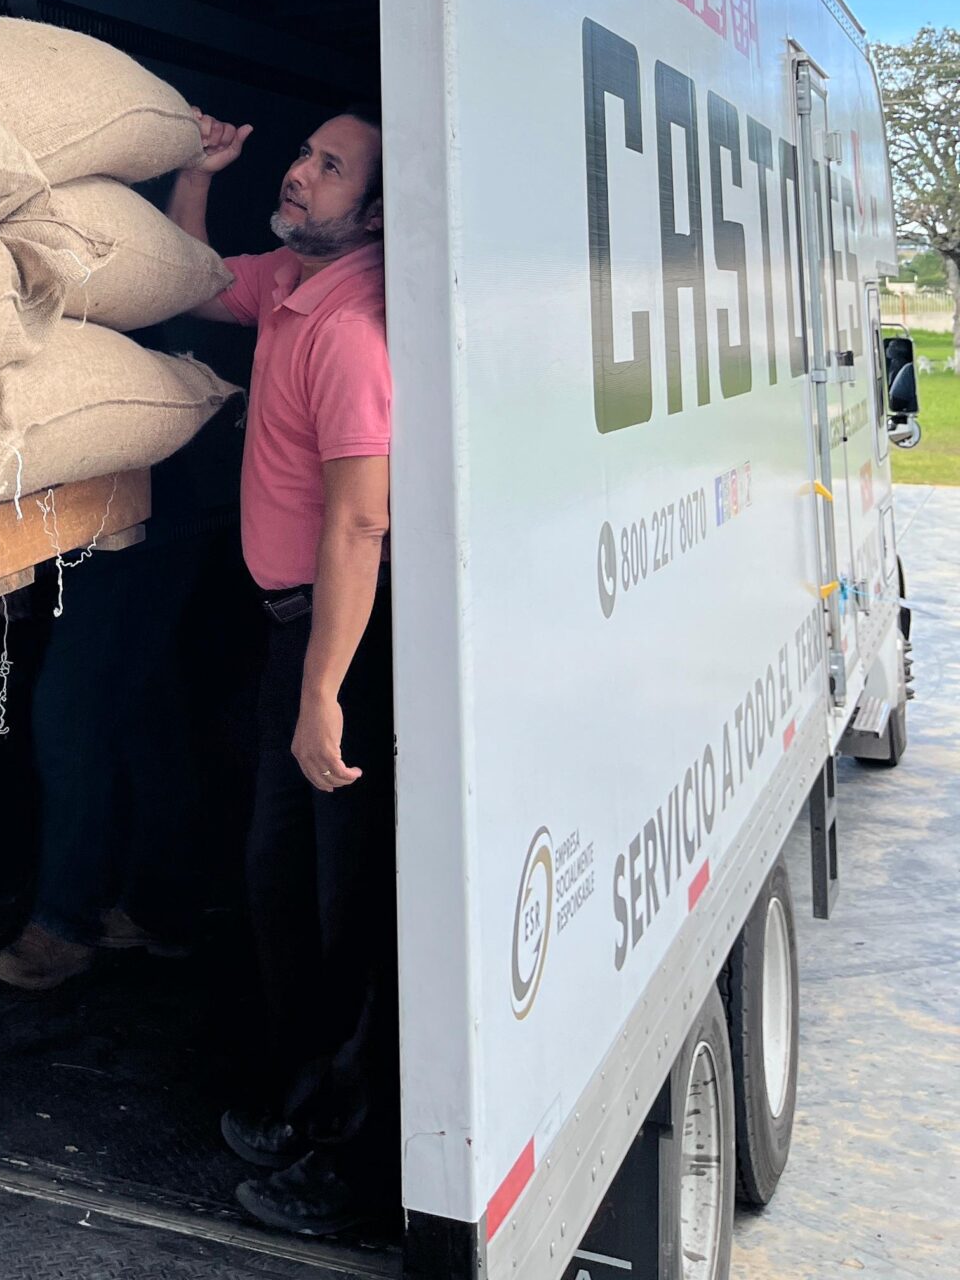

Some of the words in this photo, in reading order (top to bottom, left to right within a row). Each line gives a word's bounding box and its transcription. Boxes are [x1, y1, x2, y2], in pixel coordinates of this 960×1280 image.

[620, 517, 648, 592] 800
[652, 503, 674, 572] 227
[679, 487, 706, 554] 8070
[613, 743, 716, 972] SERVICIO
[722, 721, 735, 813] A
[735, 664, 776, 784] TODO
[779, 642, 793, 719] EL
[555, 827, 581, 873] EMPRESA
[555, 841, 594, 903] SOCIALMENTE
[556, 870, 595, 935] RESPONSABLE
